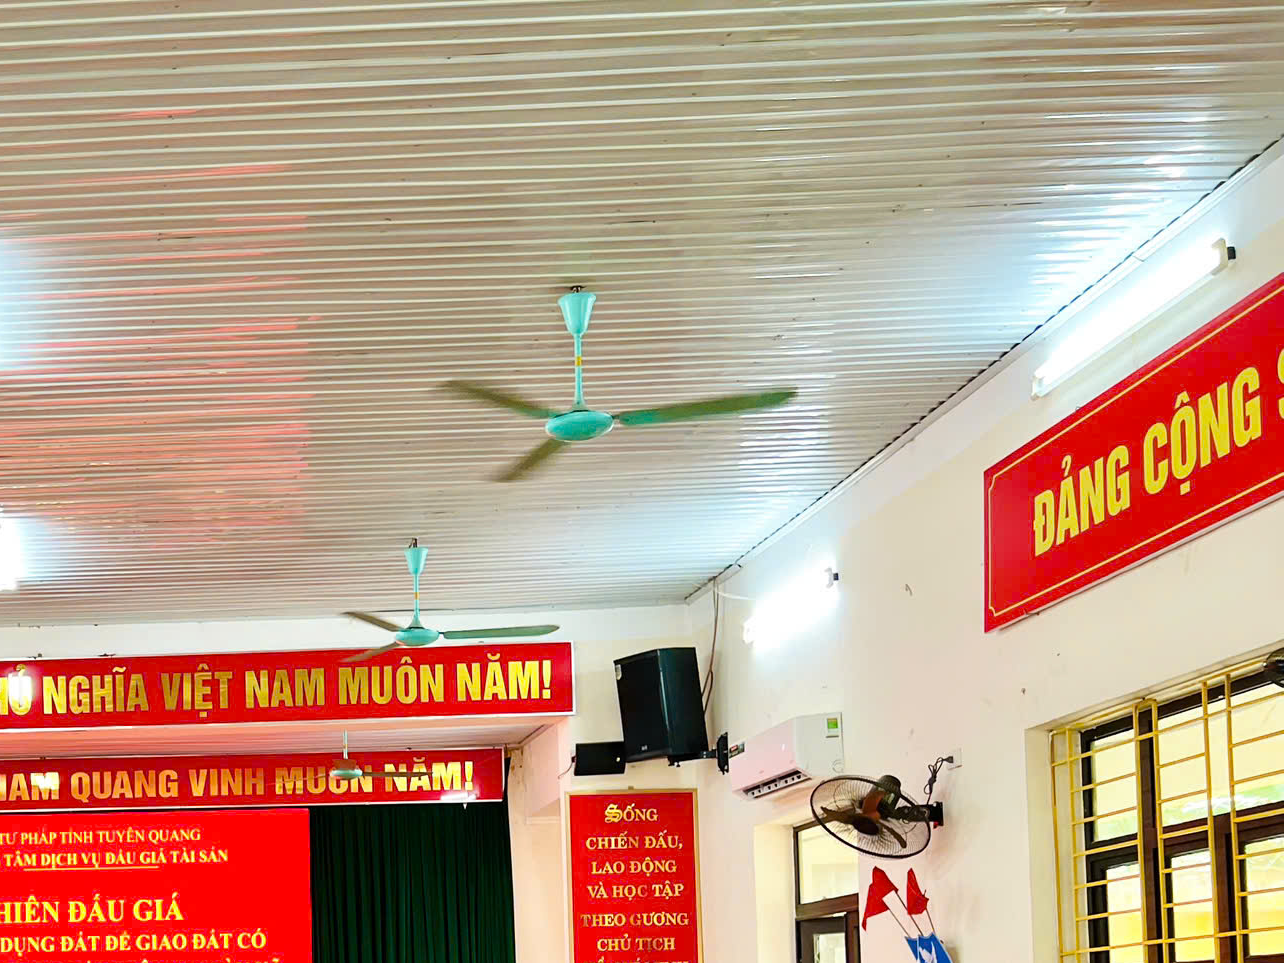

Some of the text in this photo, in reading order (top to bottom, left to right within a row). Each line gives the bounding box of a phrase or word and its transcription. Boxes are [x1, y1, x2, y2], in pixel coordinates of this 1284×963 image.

[1034, 445, 1130, 556] ĐẢNG
[1143, 367, 1261, 495] CỘNG
[43, 666, 149, 715] NGHĨA
[161, 664, 233, 717] VIỆT
[245, 668, 324, 708] NAM
[338, 656, 444, 705] MUÔN
[457, 653, 552, 701] NĂM!
[70, 769, 179, 803] QUANG
[188, 768, 265, 797] VINH
[384, 757, 474, 792] NĂM!
[96, 827, 145, 843] TUYÊN
[148, 829, 201, 844] QUANG
[585, 832, 639, 850] CHIẾN
[4, 850, 36, 867] TÂM
[40, 853, 77, 870] DỊCH
[591, 857, 677, 877] LAO ĐỘNG
[587, 880, 684, 900] VÀ HỌC TẬP
[68, 893, 124, 923] ĐẤU
[132, 892, 185, 921] GIÁ
[580, 912, 689, 927] THEO GƯƠNG
[0, 936, 55, 957] DỤNG
[135, 934, 187, 951] GIAO
[237, 928, 267, 949] CÓ
[597, 934, 675, 952] CHỦ TỊCH
